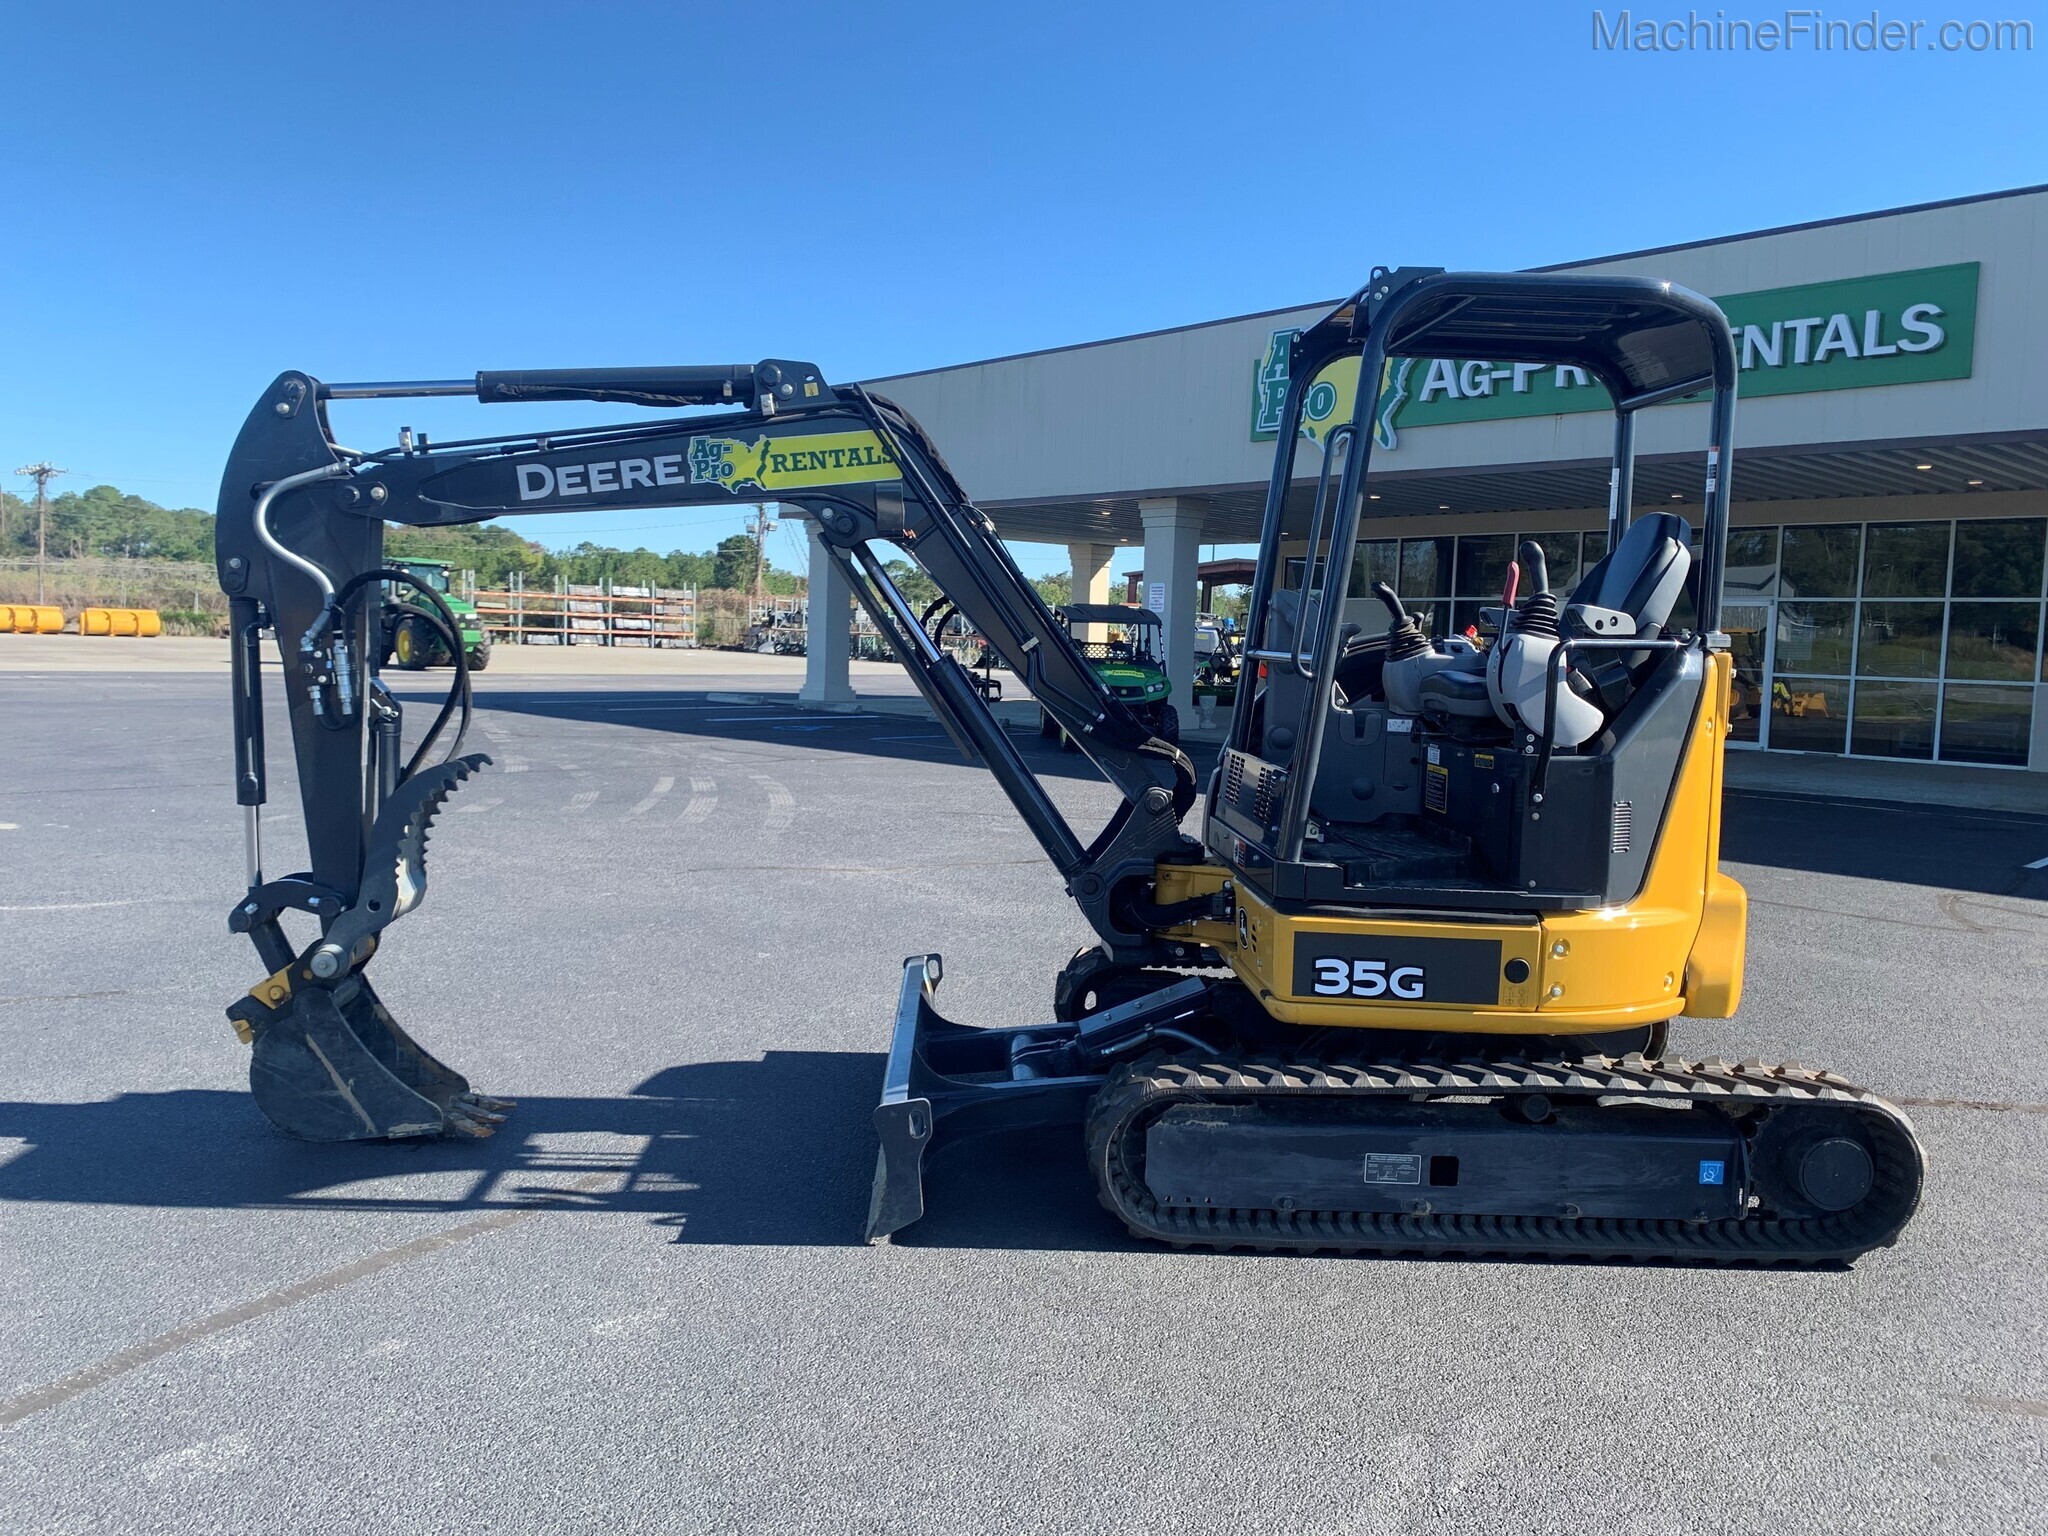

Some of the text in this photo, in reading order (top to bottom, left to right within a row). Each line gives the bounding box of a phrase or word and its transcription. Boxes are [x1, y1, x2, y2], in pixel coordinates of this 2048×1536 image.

[1418, 303, 1946, 402] AG-PR NTALS
[692, 438, 732, 463] Ag-
[771, 444, 894, 473] RENTALS
[516, 454, 685, 500] DEERE
[694, 459, 735, 480] Pro
[1314, 958, 1424, 999] 35G
